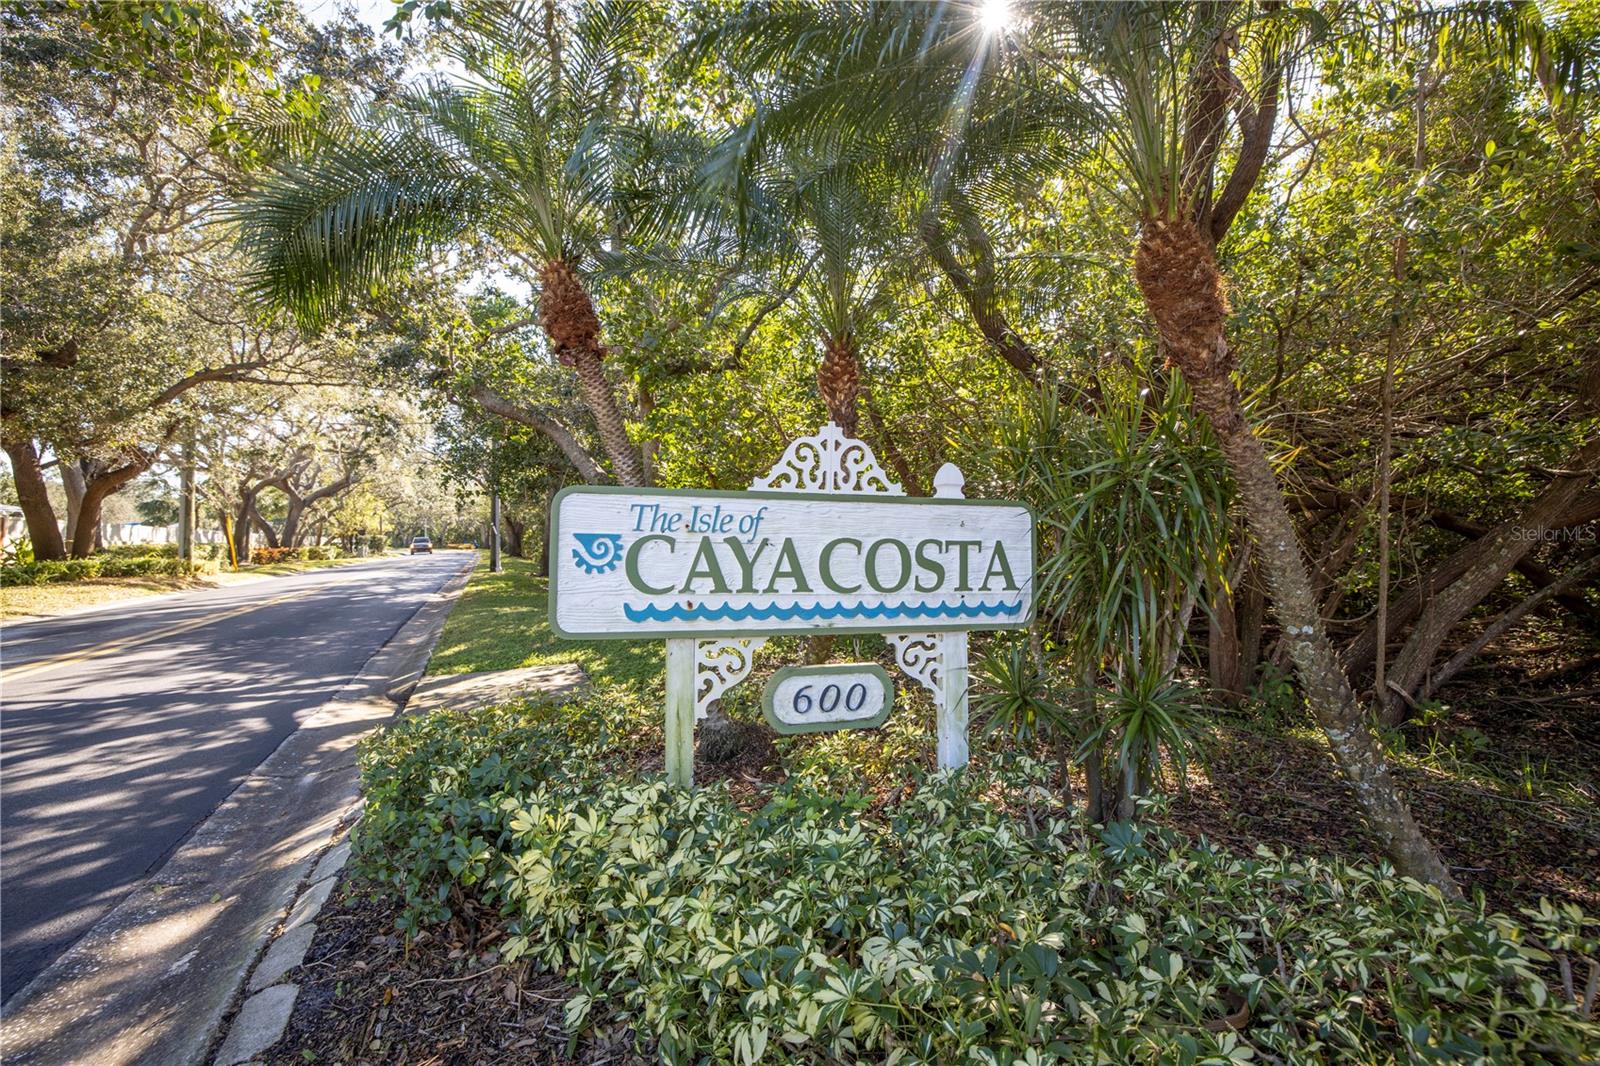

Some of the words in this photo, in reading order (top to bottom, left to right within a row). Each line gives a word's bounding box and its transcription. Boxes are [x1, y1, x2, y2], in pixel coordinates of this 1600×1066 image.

[630, 503, 683, 532] The
[688, 505, 735, 534] Isle
[738, 506, 768, 544] of
[793, 683, 867, 715] 600
